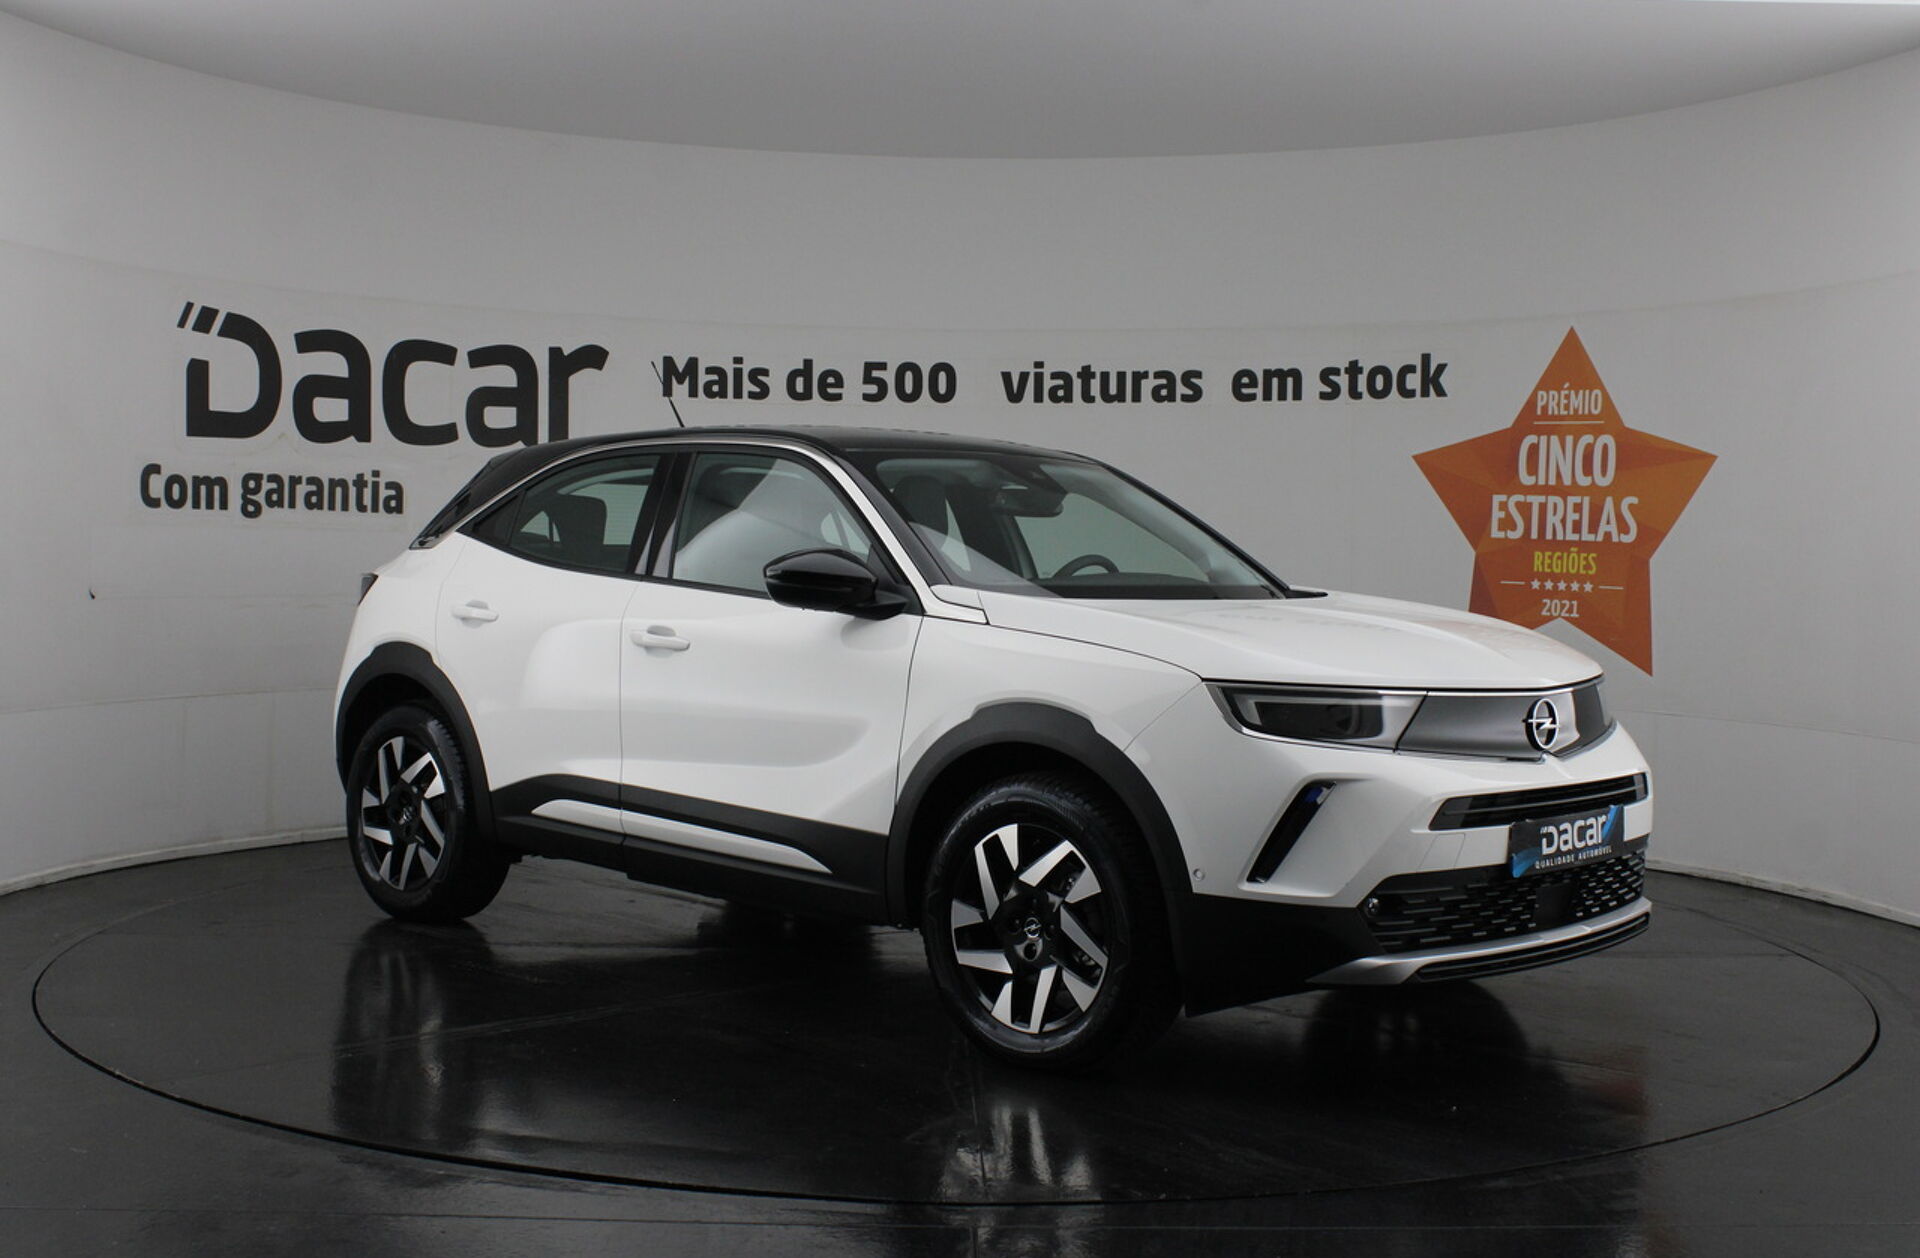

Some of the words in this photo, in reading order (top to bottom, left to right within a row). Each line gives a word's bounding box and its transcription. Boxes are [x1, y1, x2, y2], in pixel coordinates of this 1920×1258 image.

[177, 301, 609, 447] Dacar
[661, 356, 770, 400] Mais
[785, 358, 844, 402] de
[862, 361, 957, 403] 500
[1001, 360, 1203, 404] viaturas
[1231, 365, 1302, 402] em
[1319, 353, 1448, 400] stock
[1536, 382, 1602, 415] PRÉMIO
[1518, 434, 1616, 487] CINCO
[140, 463, 228, 511] Com
[241, 470, 404, 519] garantia
[1490, 494, 1638, 543] ESTRELAS
[1533, 547, 1597, 575] REGIÕES
[1541, 599, 1579, 617] 2021
[1541, 815, 1606, 854] Dacar
[1536, 854, 1575, 869] QUALIDADE
